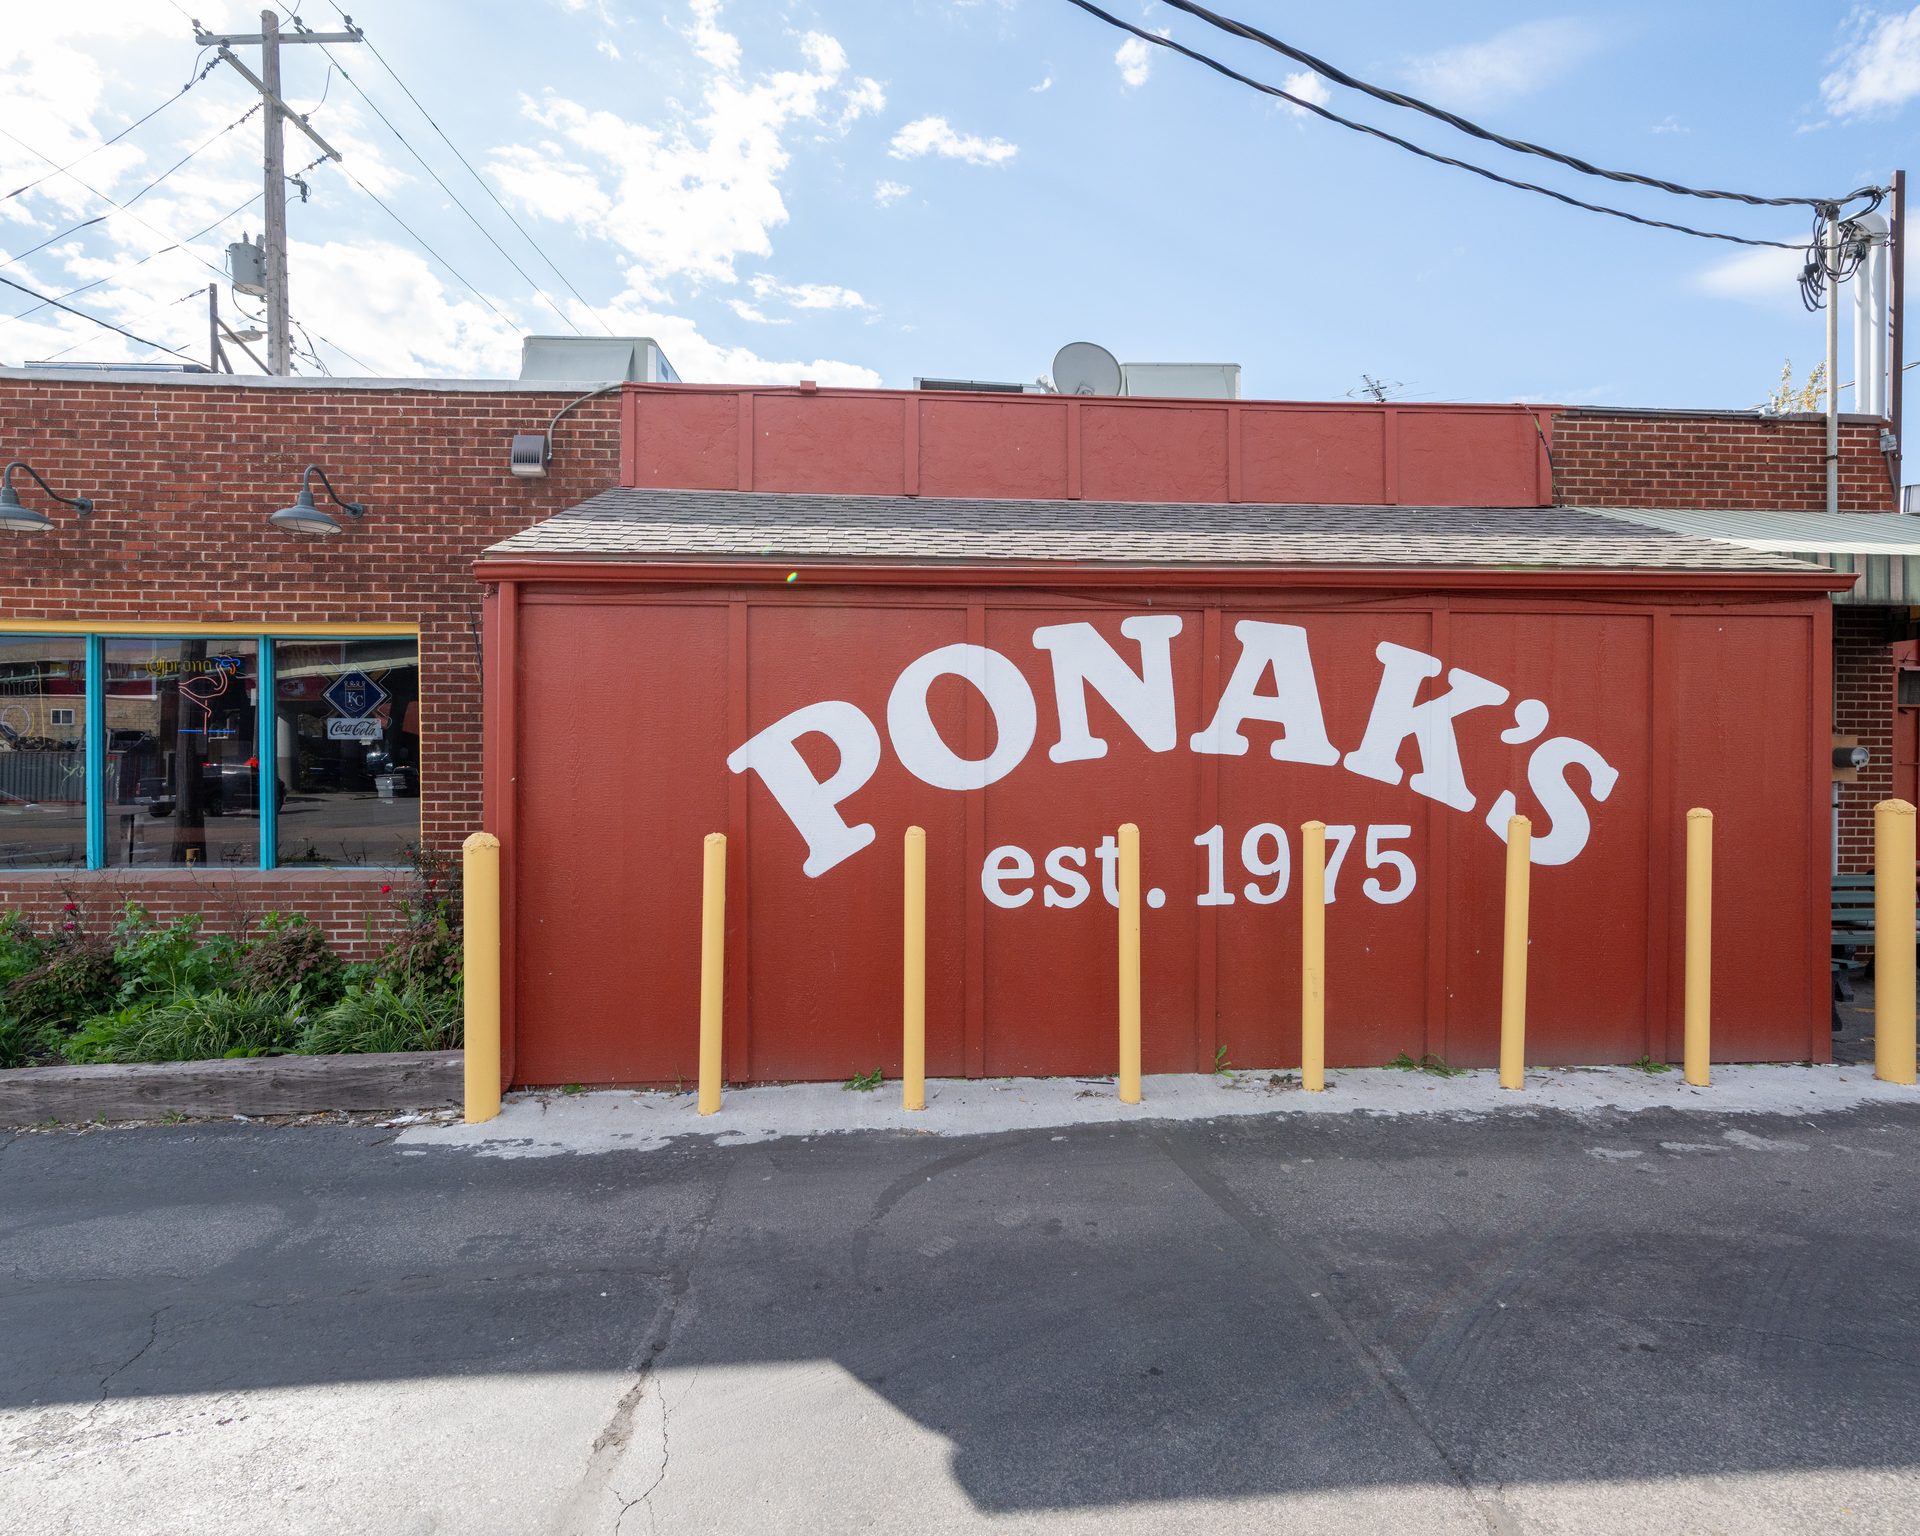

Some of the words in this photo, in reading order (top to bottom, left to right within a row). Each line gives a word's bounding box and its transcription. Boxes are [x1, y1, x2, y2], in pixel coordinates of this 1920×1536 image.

[146, 656, 212, 678] Corona
[347, 691, 364, 707] KC
[726, 614, 1619, 880] PONAK'S
[981, 835, 1166, 909] est.
[1193, 822, 1417, 906] 1975
